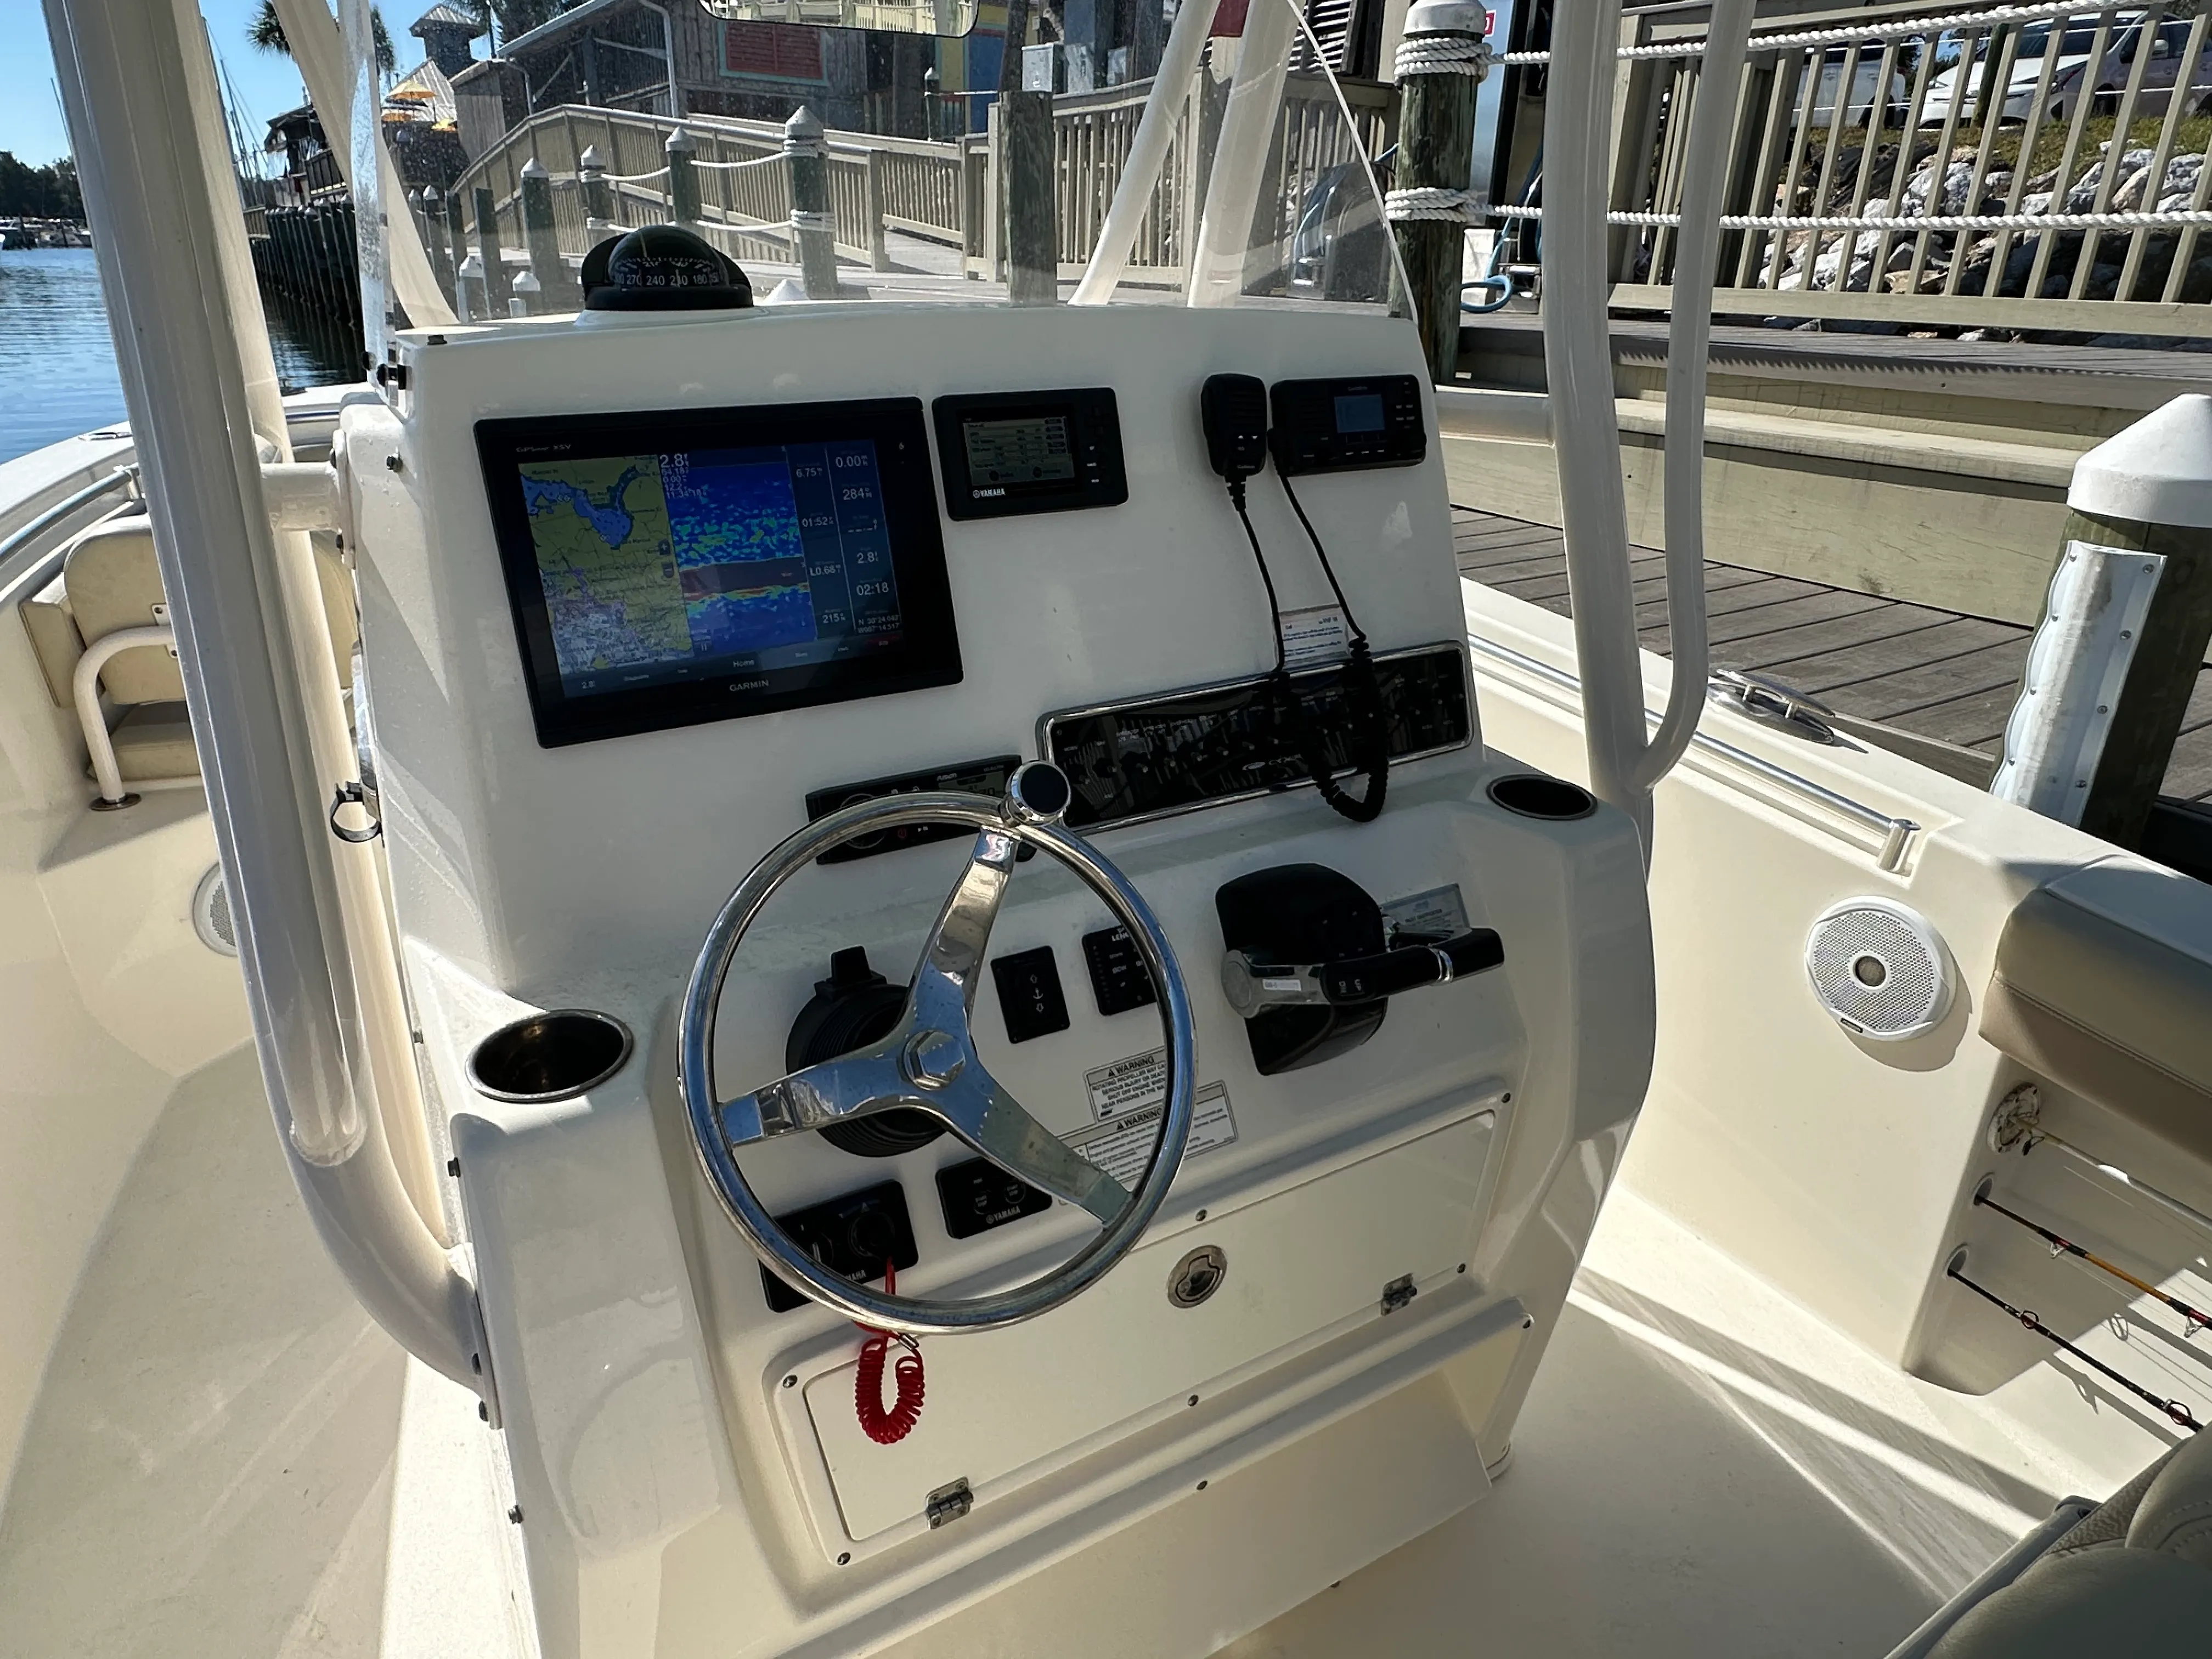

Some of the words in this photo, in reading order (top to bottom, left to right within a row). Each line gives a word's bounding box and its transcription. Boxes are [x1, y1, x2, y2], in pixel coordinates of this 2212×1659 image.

[646, 275, 665, 285] 240
[669, 275, 689, 286] 210
[693, 275, 708, 285] 180
[835, 455, 861, 468] 0.00
[795, 467, 817, 478] 6.75
[842, 487, 865, 500] 284
[980, 487, 1006, 497] YAMAHA
[856, 582, 889, 596] 02:18
[822, 613, 839, 624] 215
[729, 679, 770, 692] GARMIN
[1115, 1056, 1154, 1074] WARNING
[994, 1205, 1021, 1222] YAMAHA
[845, 1268, 867, 1282] MAHA
